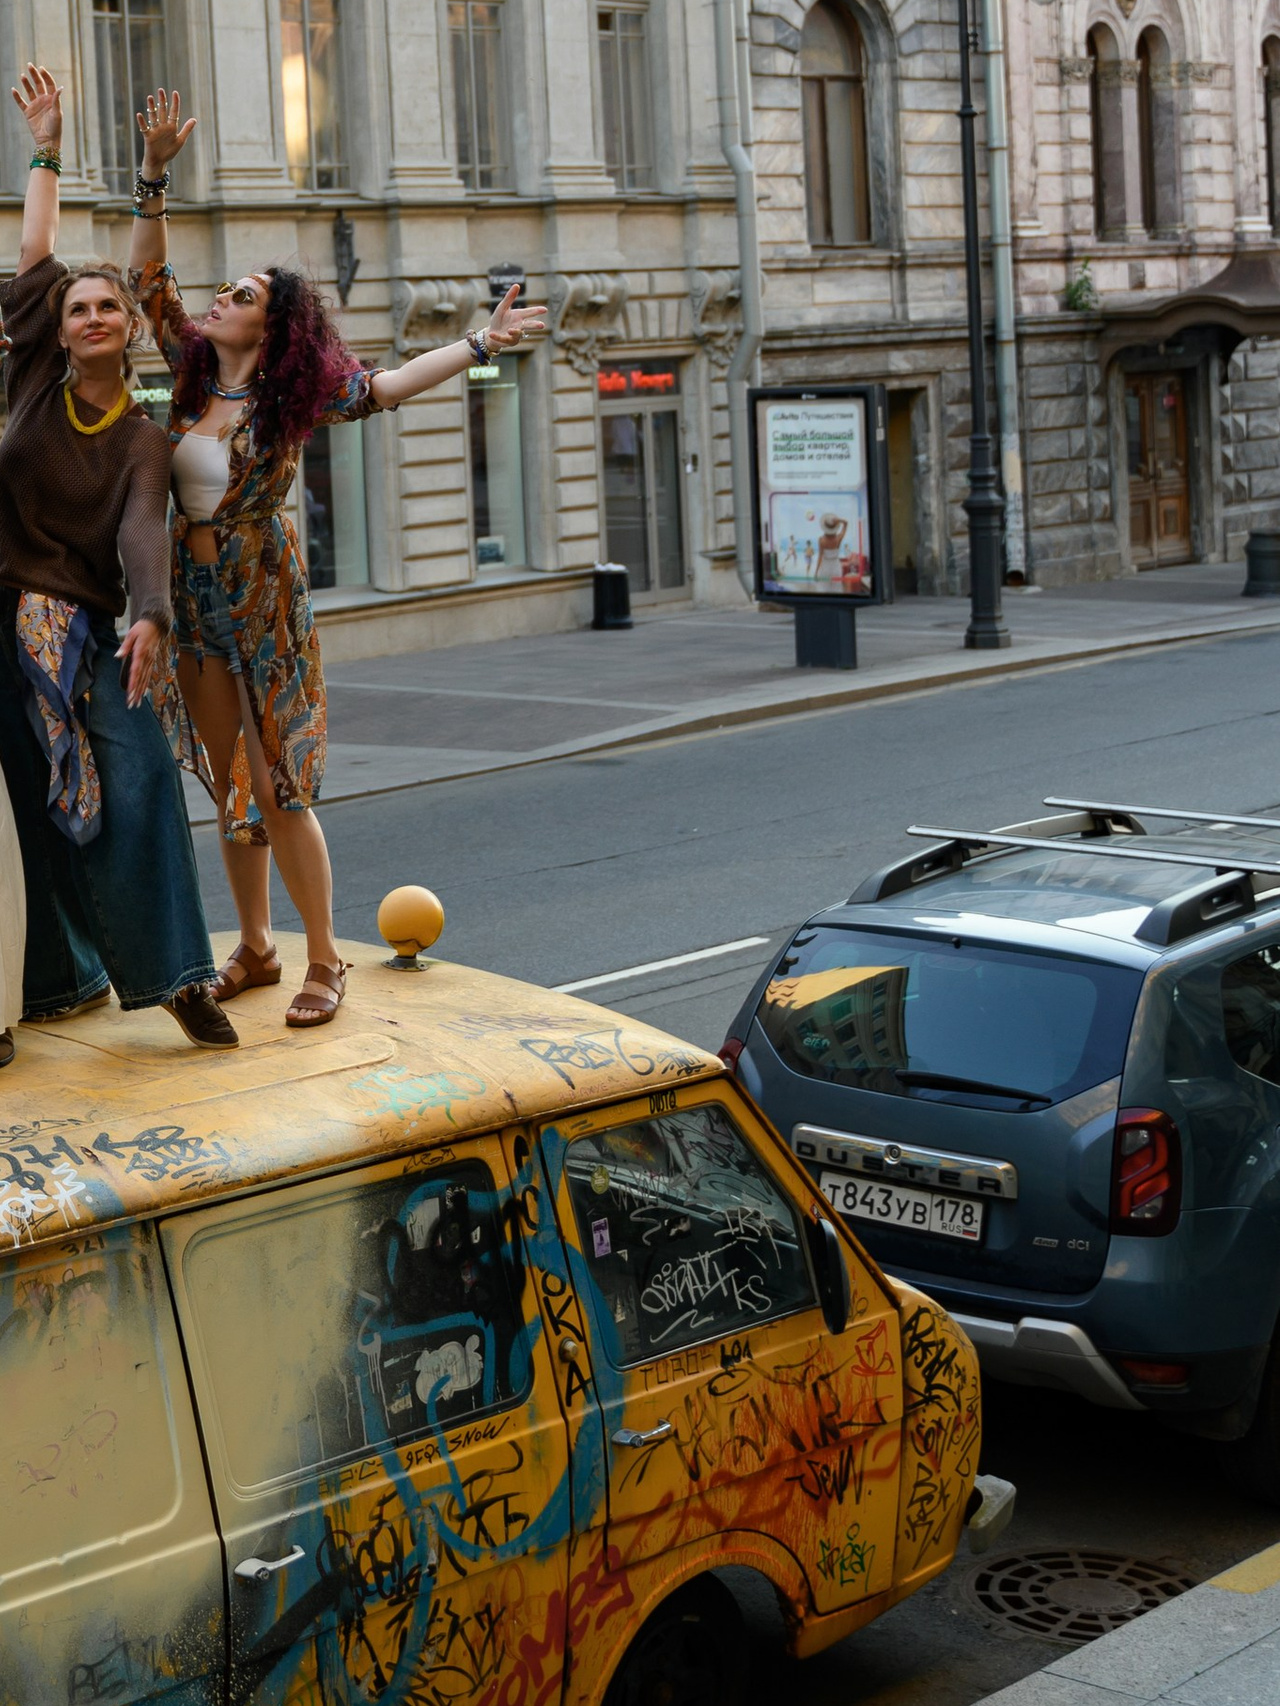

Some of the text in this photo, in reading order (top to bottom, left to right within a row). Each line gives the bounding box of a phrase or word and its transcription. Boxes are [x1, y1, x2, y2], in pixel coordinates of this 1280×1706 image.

[772, 429, 854, 440] Самый большой
[773, 441, 805, 451] выбор
[773, 453, 806, 461] домов
[815, 451, 851, 461] отелей
[796, 1141, 1001, 1194] DUSTER
[934, 1198, 975, 1226] 178
[941, 1221, 962, 1234] RUS
